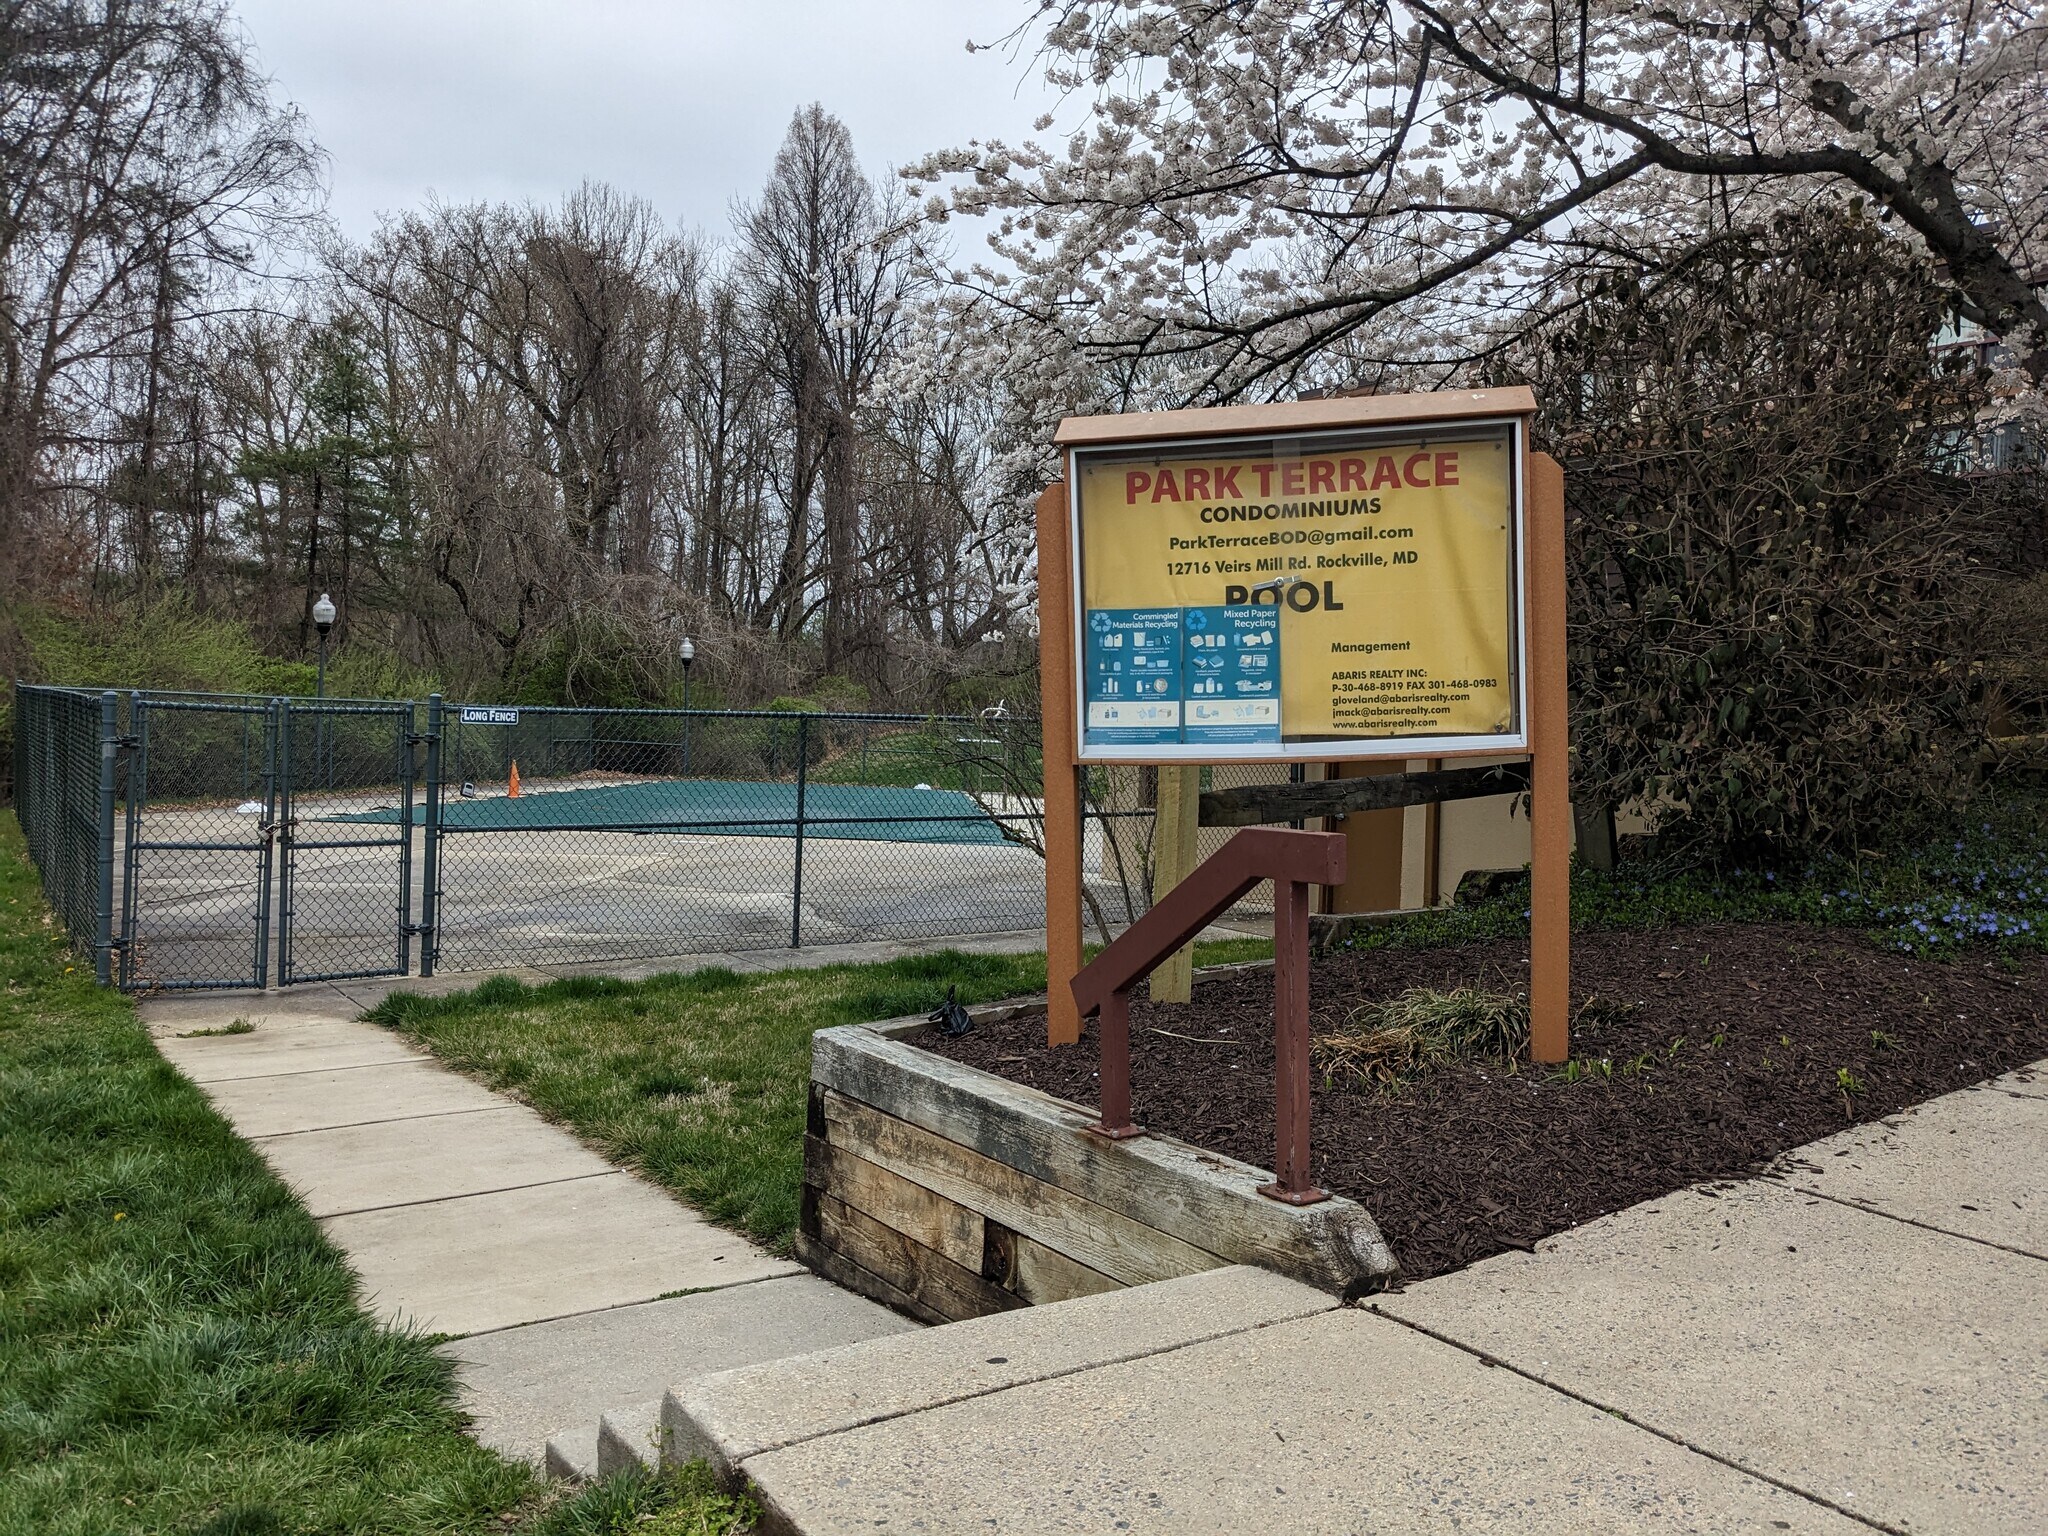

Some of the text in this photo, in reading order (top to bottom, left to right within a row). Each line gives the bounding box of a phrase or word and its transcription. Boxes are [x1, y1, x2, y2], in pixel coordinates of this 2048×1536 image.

[1126, 451, 1460, 505] PARK TERRACE
[1200, 497, 1382, 524] CONDOMINIUMS
[1169, 526, 1414, 550] ParkTerraceBOD@gmail.com
[1167, 550, 1418, 576] 12716 Veirs Mill Rd. Rockville, MD
[1225, 580, 1344, 613] POOL
[1133, 612, 1178, 623] Commingled
[1224, 609, 1276, 619] Mixed Paper
[1112, 619, 1178, 629] Materials Recycling
[1234, 619, 1276, 629] Recycling
[1331, 641, 1410, 654] Management
[1331, 669, 1427, 680] ABARIS REALTY INC:
[1332, 679, 1497, 692] P-30-468-8919 FAX 301-468-0983
[1332, 692, 1470, 706] gloveland@abarisrealty.com
[464, 709, 516, 722] LONG FENCE
[1332, 705, 1450, 718] jmack@abarisrealty.com
[1333, 718, 1437, 729] www.abarisrealty.com
